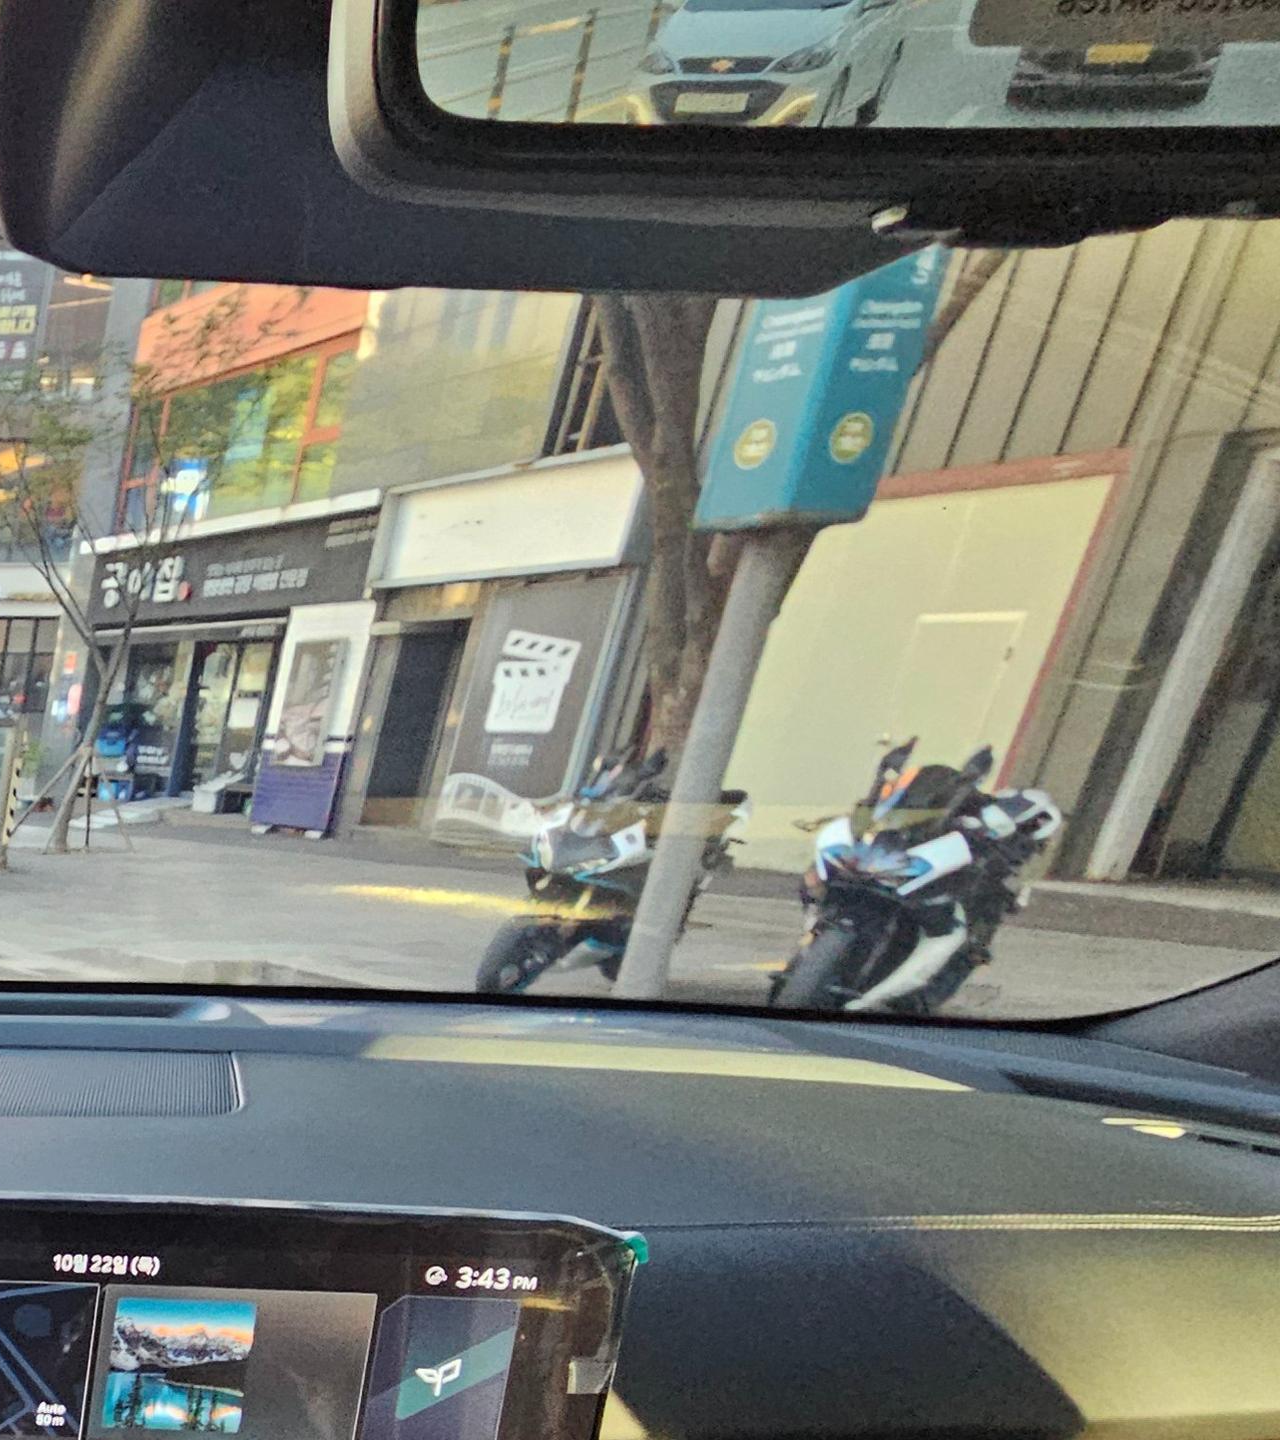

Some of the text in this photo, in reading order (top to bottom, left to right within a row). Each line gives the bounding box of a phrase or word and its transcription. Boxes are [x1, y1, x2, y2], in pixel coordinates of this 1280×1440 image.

[53, 1253, 87, 1272] 10월
[90, 1255, 128, 1274] 22일
[455, 1266, 538, 1291] 3:43 PM
